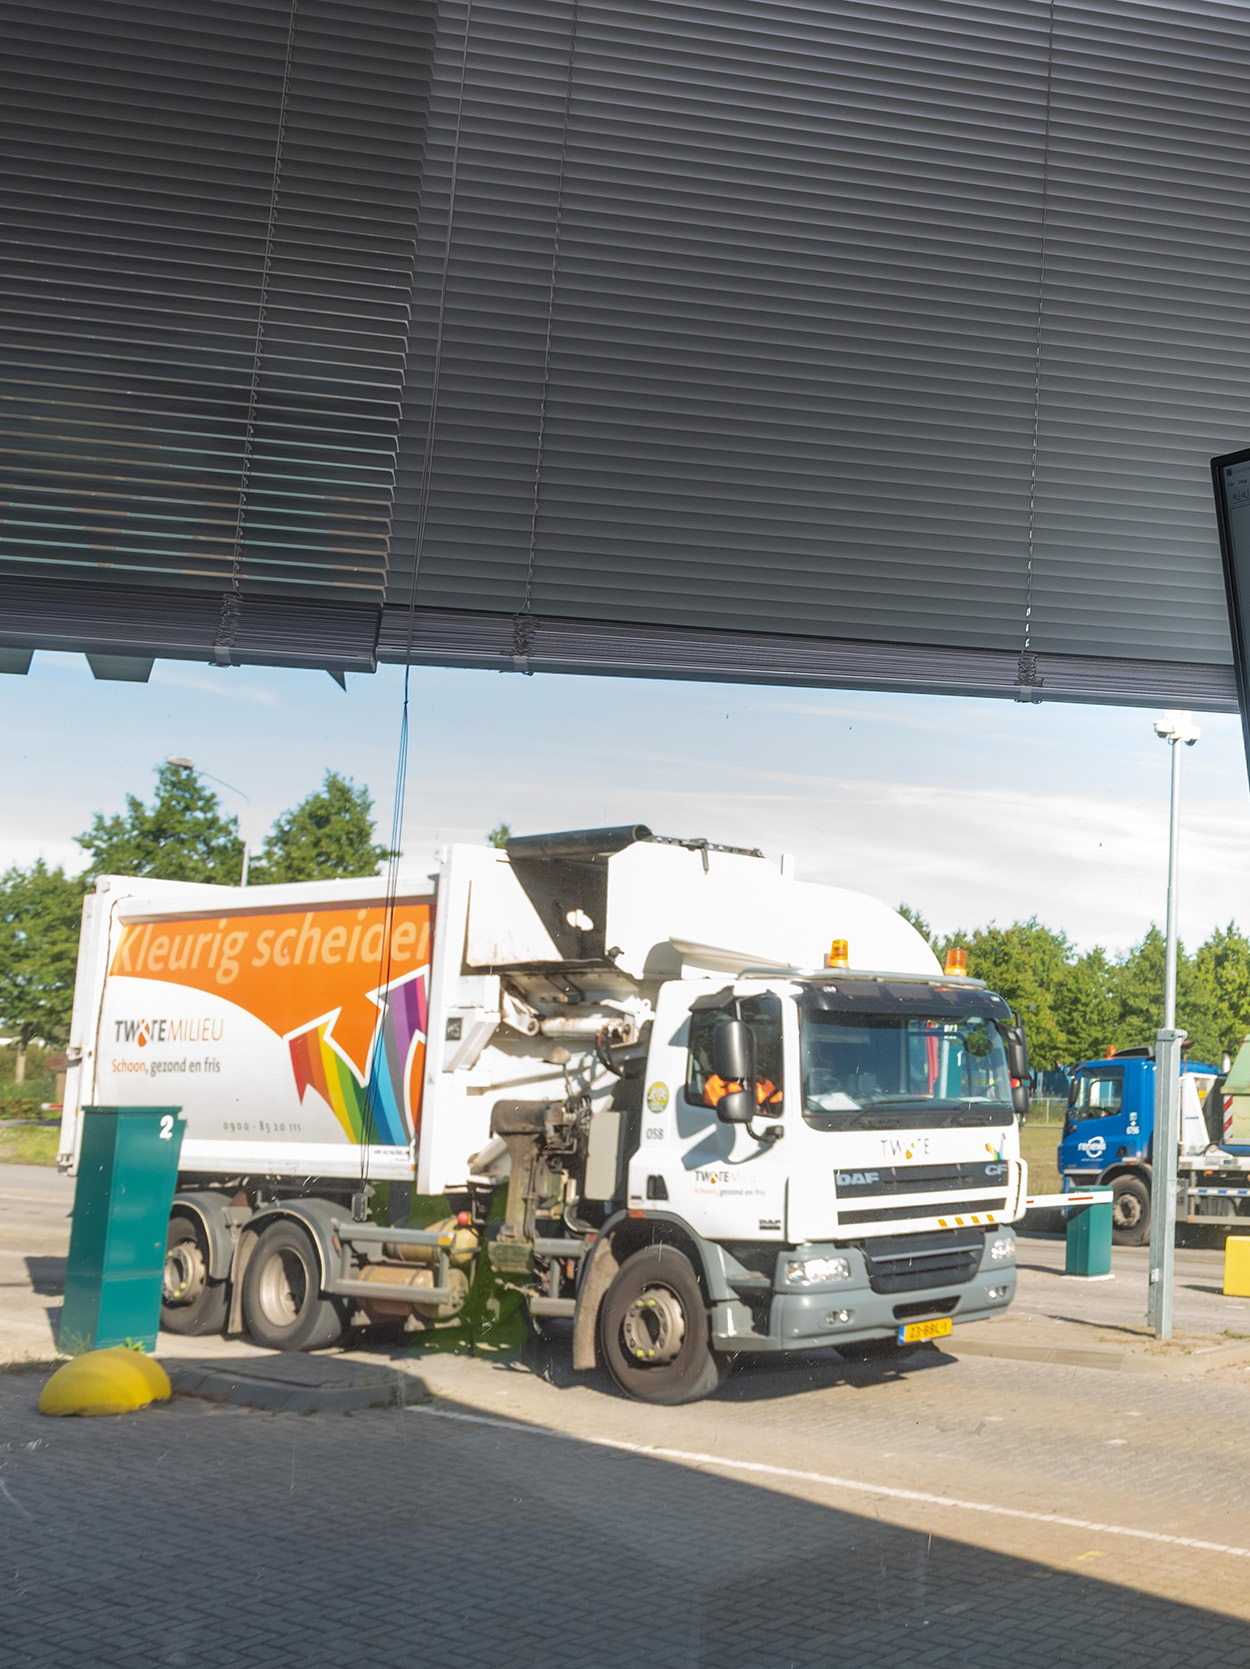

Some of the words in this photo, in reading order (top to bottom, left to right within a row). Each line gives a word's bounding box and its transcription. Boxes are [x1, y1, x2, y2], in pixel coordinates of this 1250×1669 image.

[116, 918, 248, 985] Kleurig
[112, 1058, 149, 1075] Schoon,
[150, 1057, 186, 1077] gezond
[189, 1060, 201, 1072] en
[204, 1057, 221, 1072] fris
[160, 1115, 174, 1138] 2
[646, 1128, 664, 1139] 058
[985, 1163, 1007, 1176] CF
[836, 1172, 879, 1186] DAF
